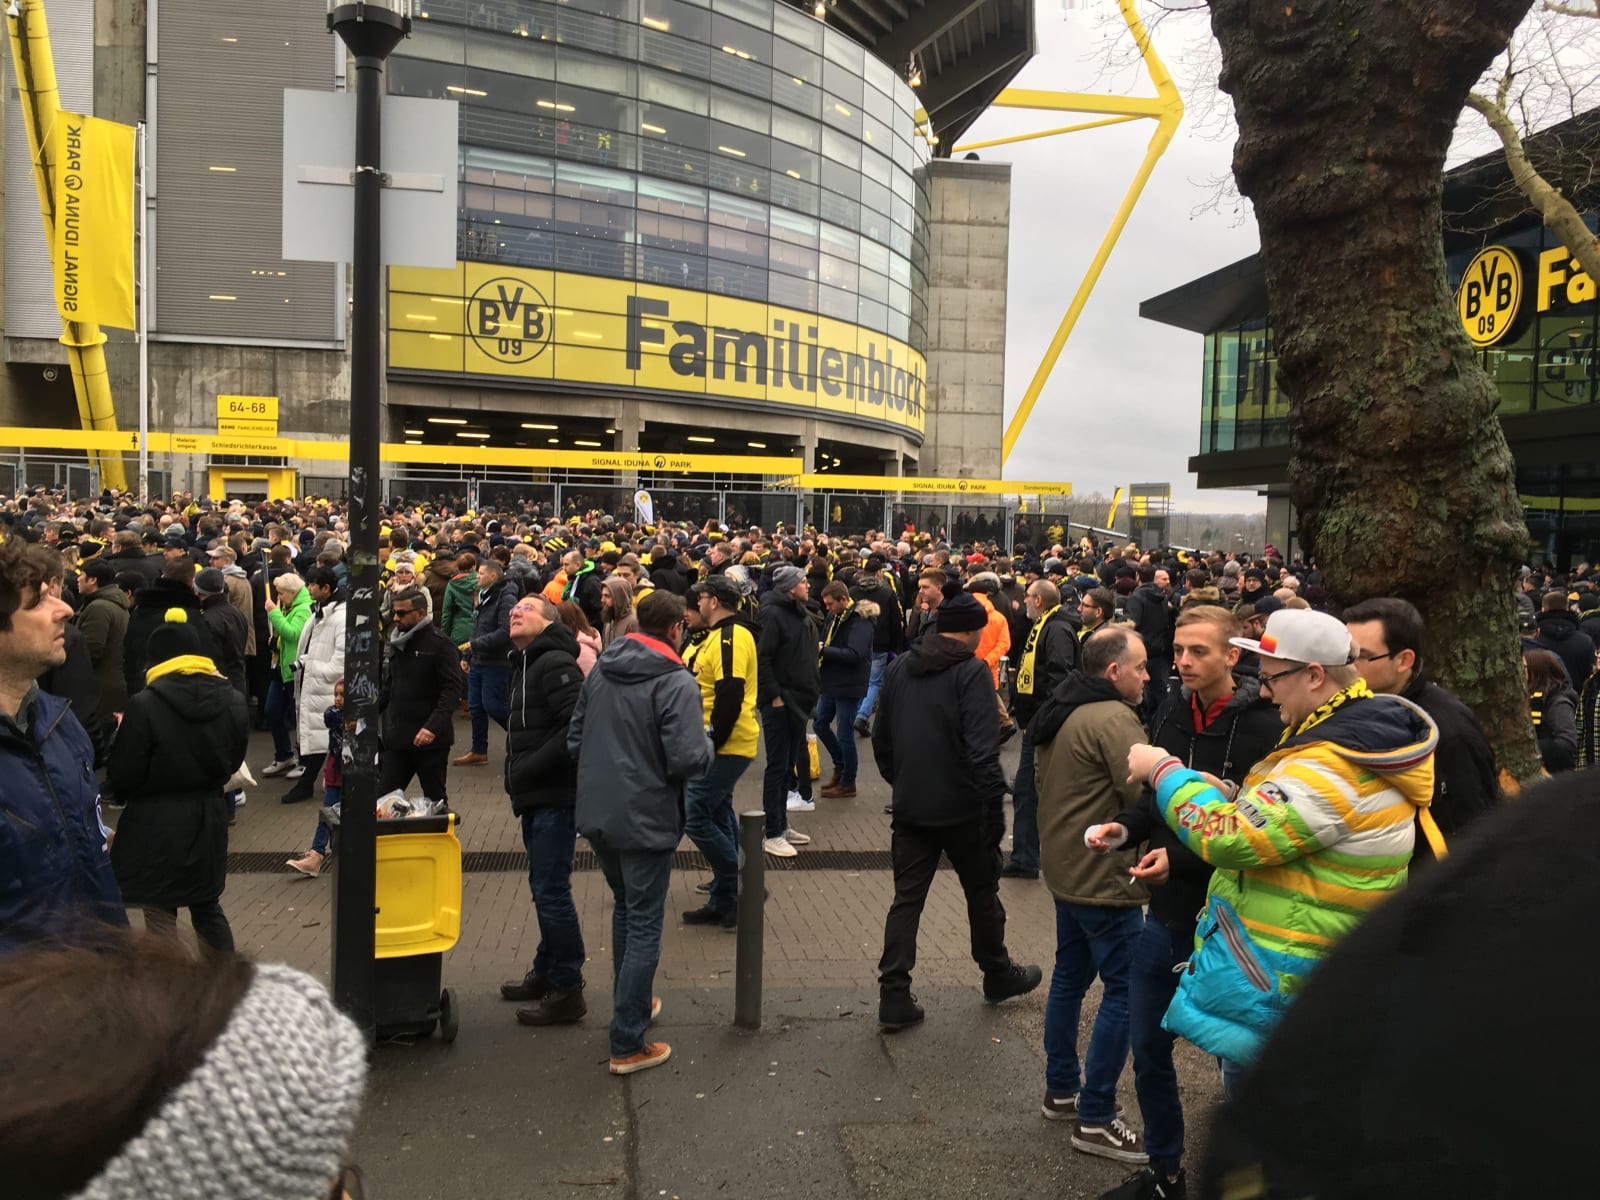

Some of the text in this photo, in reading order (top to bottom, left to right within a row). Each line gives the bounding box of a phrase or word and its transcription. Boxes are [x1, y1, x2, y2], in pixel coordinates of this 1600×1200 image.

[1466, 256, 1512, 319] BVB
[479, 285, 544, 339] BVB
[1478, 313, 1495, 335] 09
[498, 338, 522, 356] 09
[626, 295, 921, 419] Familienblock
[230, 401, 266, 413] 64-68
[211, 441, 277, 451] Schiedsrichterkasse
[592, 458, 692, 468] SIGNAL IDUNA PARK
